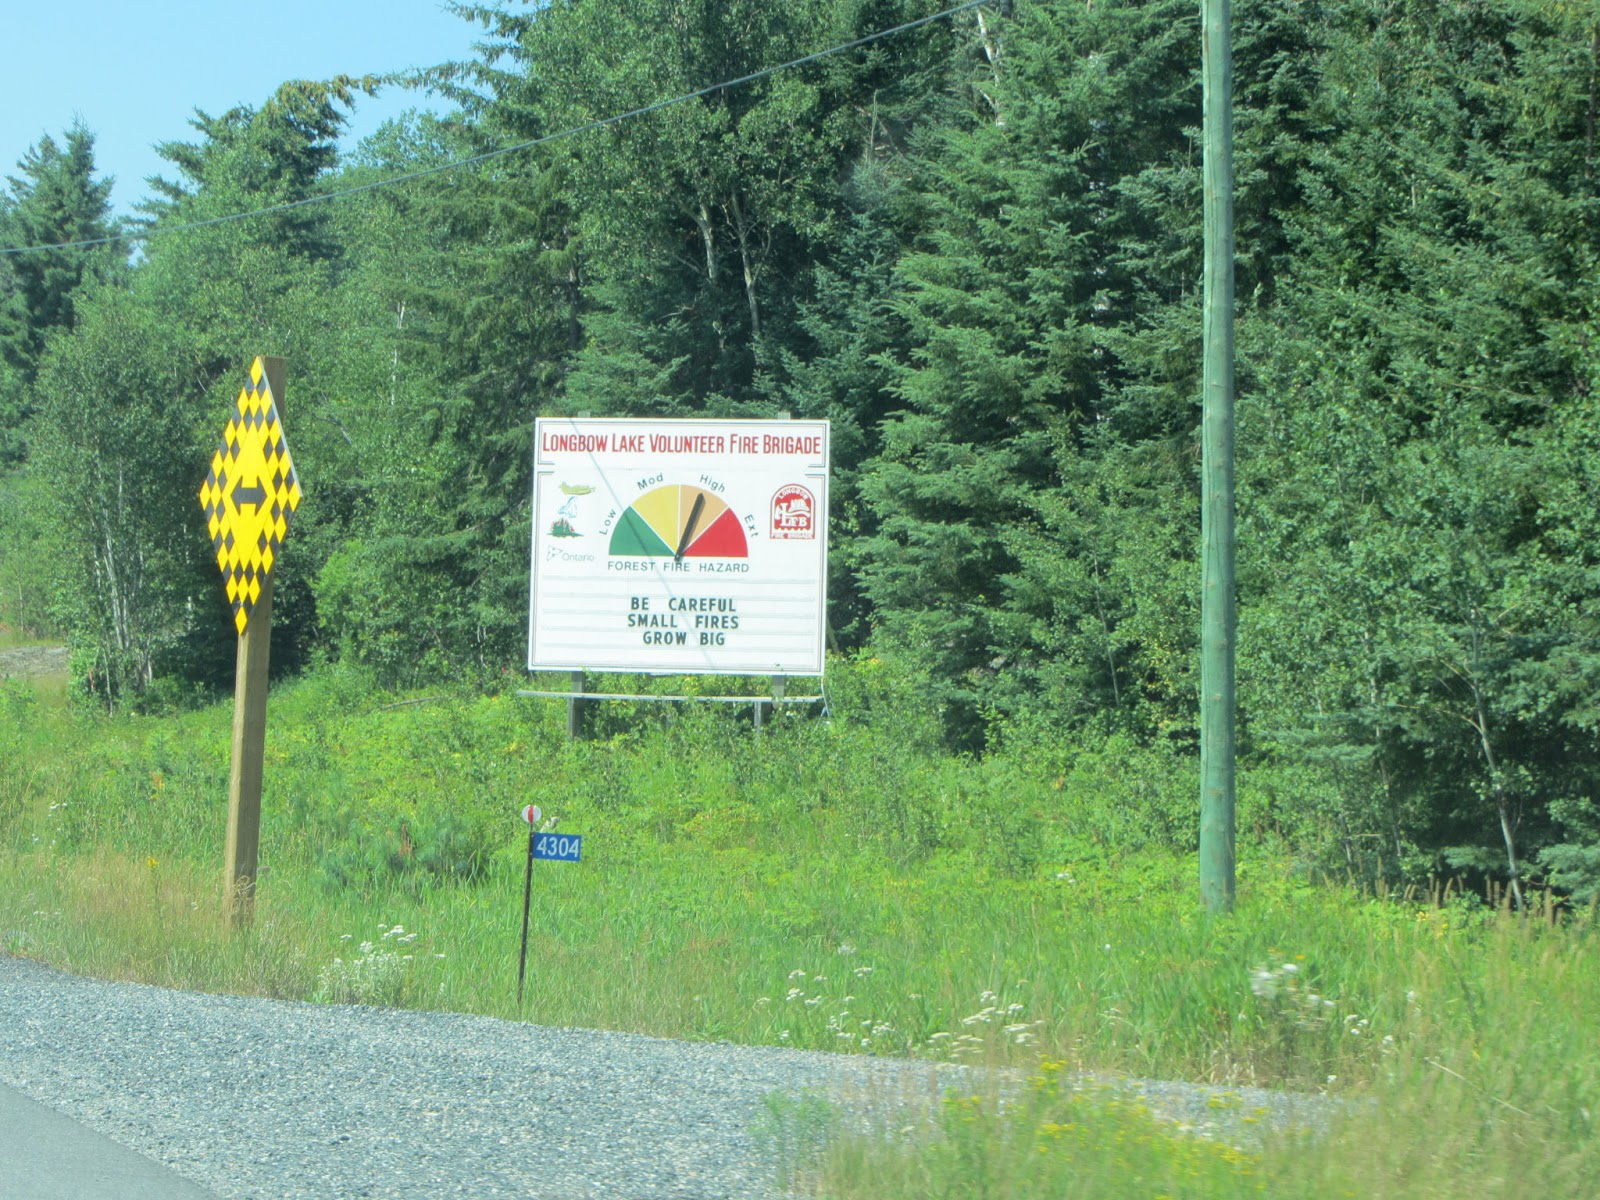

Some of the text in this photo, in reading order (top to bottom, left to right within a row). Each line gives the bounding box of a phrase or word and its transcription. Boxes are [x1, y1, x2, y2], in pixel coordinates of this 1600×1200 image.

[543, 432, 822, 455] LONGBOW LAKE VOLUNTEER FIRE BRIGADE
[637, 472, 664, 490] Mod
[700, 474, 726, 493] High
[599, 508, 617, 536] Low
[744, 514, 759, 538] Ext
[562, 552, 595, 561] Ontario
[607, 561, 750, 573] FOREST FIRE HAZARD
[631, 597, 737, 612] BE CAREFUL
[627, 614, 739, 629] SMALL FIRES
[642, 631, 725, 646] GROW BIG
[536, 836, 579, 858] 4304
